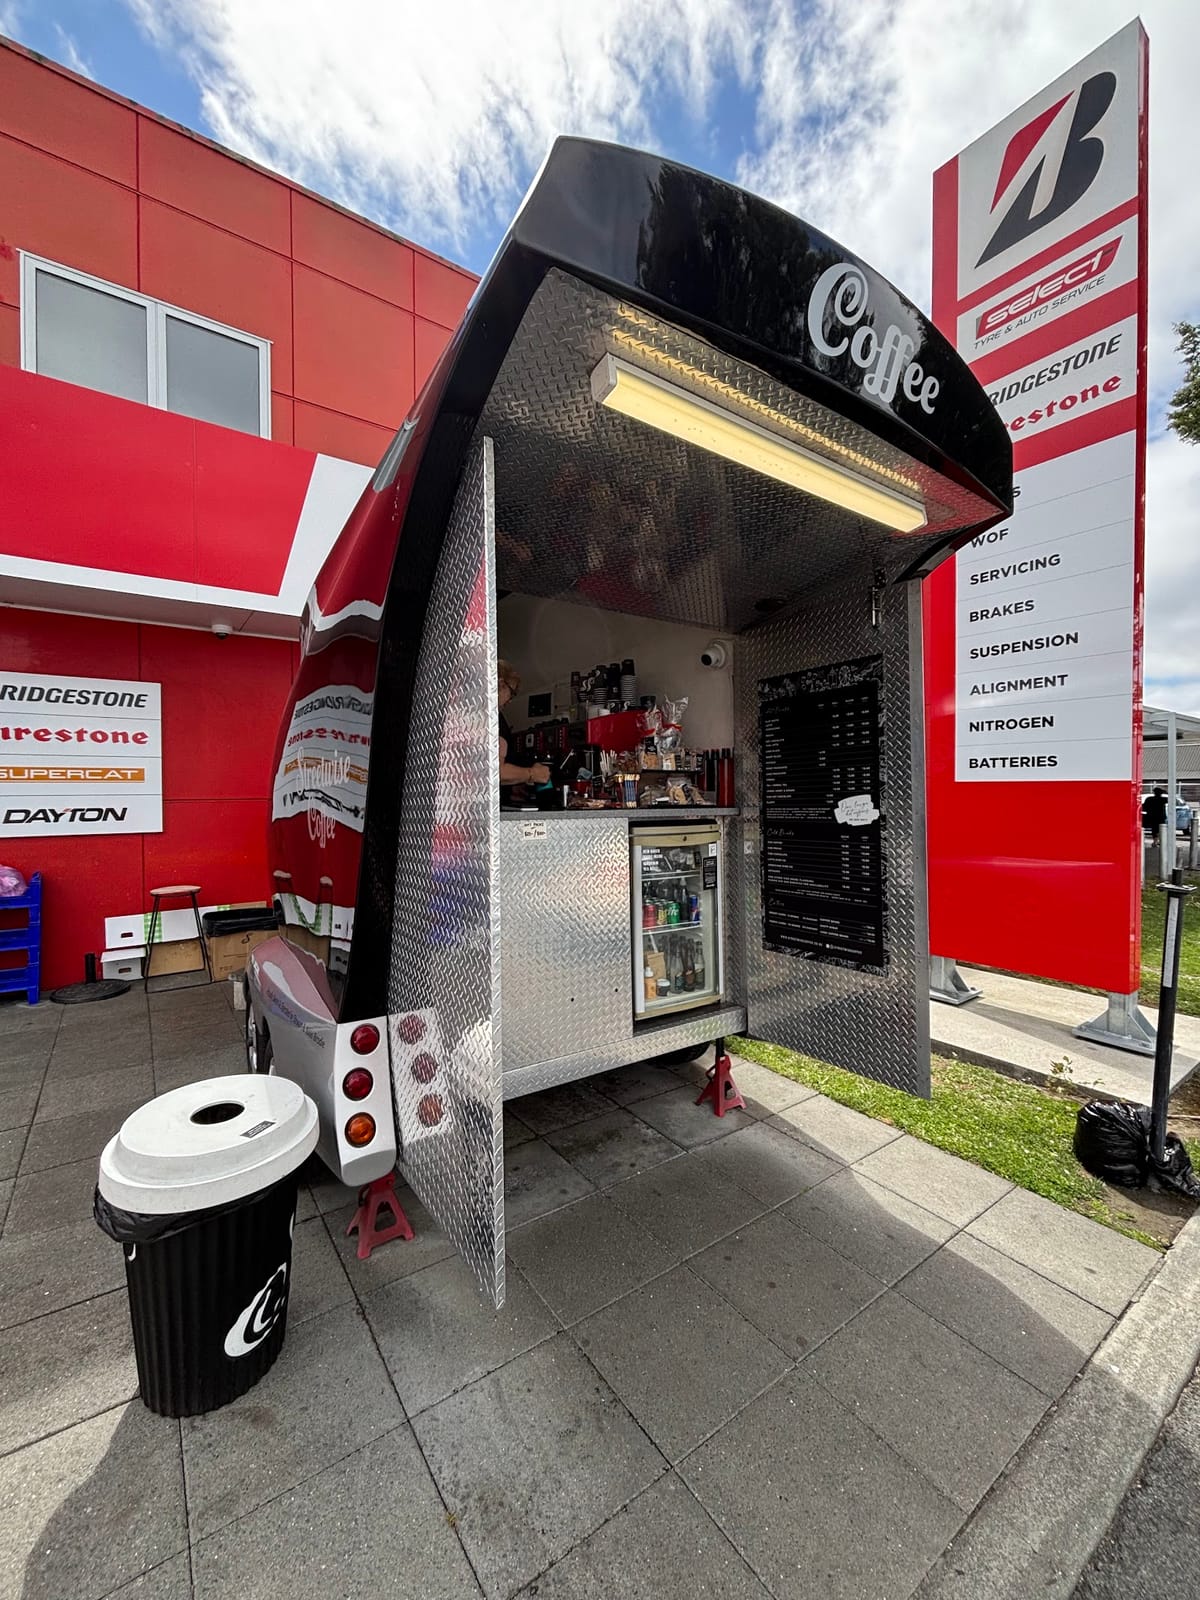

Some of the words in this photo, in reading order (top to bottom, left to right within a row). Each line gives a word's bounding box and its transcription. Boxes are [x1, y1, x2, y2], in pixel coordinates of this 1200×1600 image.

[973, 329, 1002, 350] TYRE
[1004, 323, 1014, 333] &
[1015, 305, 1049, 328] AUTO
[1051, 273, 1106, 310] SERVICE
[807, 262, 940, 415] Coffee
[989, 333, 1122, 406] RIDGESTONE
[1005, 375, 1122, 432] estone
[970, 528, 1009, 549] WOF
[970, 553, 1061, 585] SERVICING
[969, 599, 1035, 623] BRAKES
[969, 631, 1079, 660] SUSPENSION
[0, 684, 149, 708] RIDGESTONE
[969, 673, 1069, 696] ALIGNMENT
[0, 726, 149, 745] irestone
[968, 715, 1055, 733] NITROGEN
[295, 747, 351, 796] Streetwise
[968, 754, 1059, 769] BATTERIES
[2, 807, 128, 824] DAYTON
[306, 798, 336, 849] Coffee
